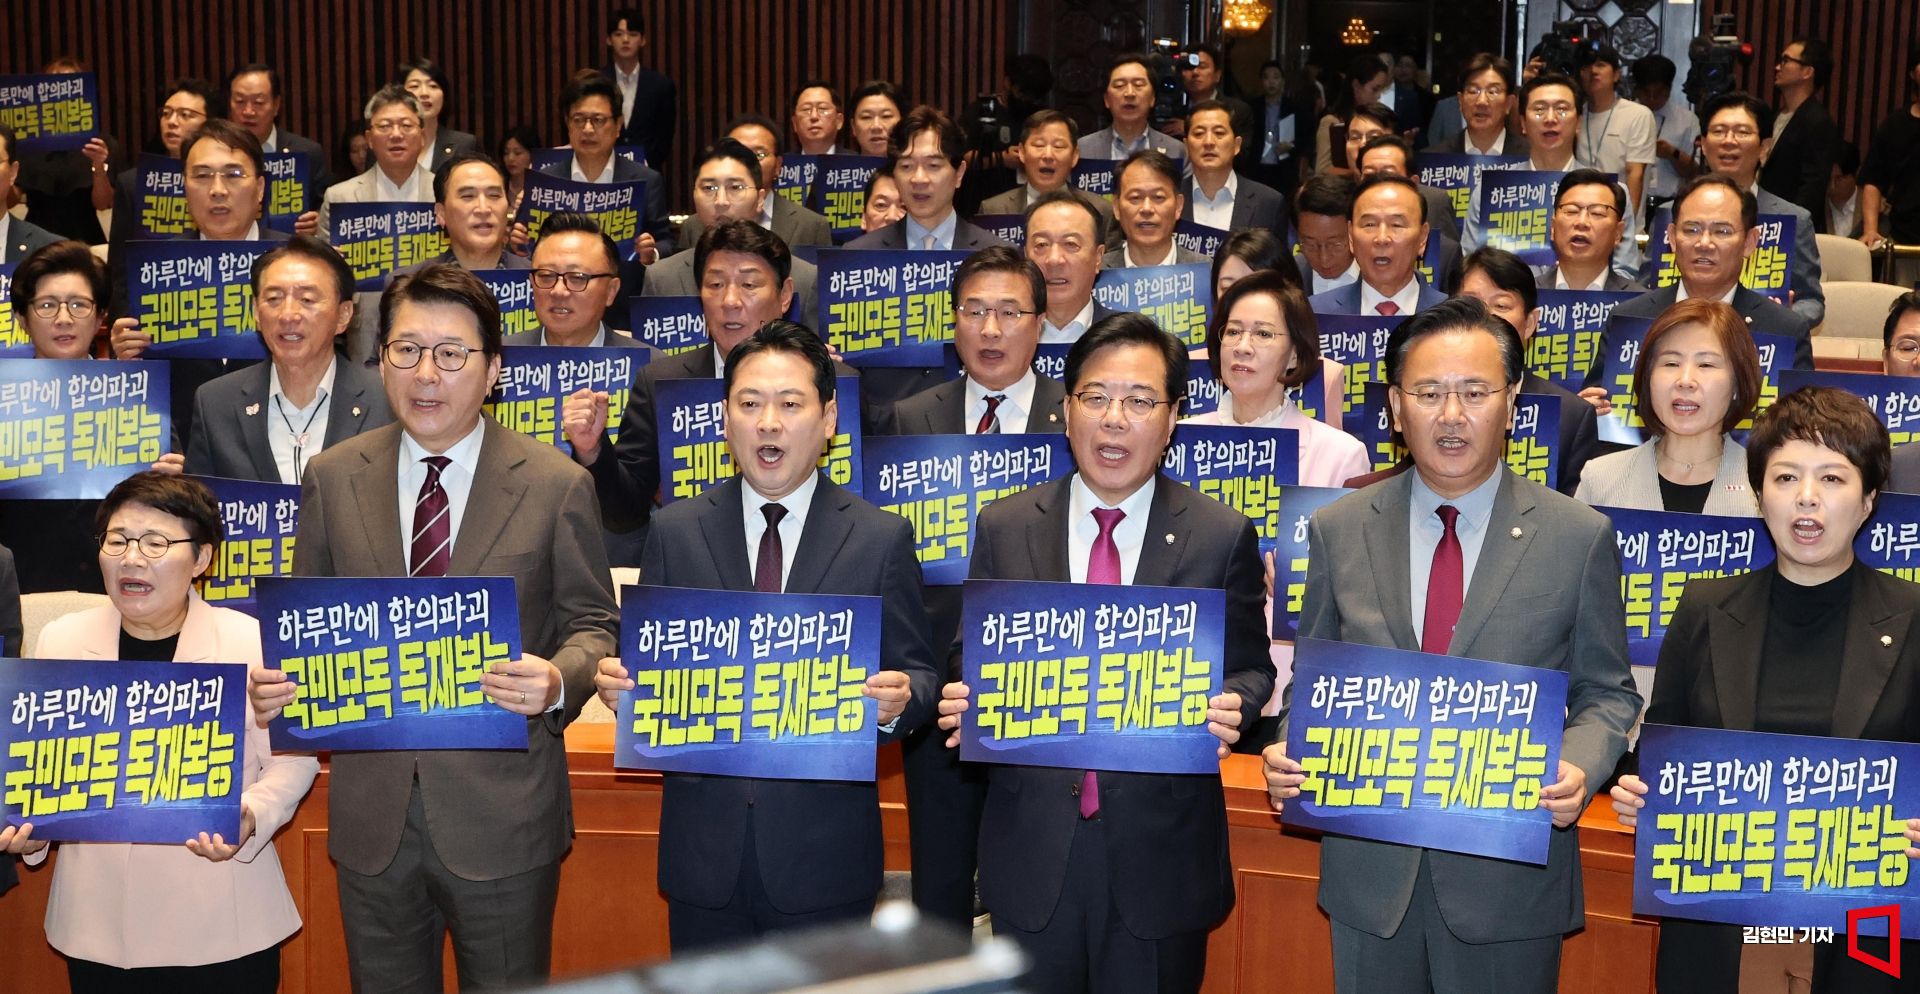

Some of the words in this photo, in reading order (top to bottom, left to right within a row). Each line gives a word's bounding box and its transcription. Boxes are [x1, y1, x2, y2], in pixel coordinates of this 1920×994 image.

[37, 78, 84, 103] 합의파괴
[41, 97, 93, 137] 독재본능
[531, 185, 580, 212] 하루만에
[583, 186, 634, 213] 합의파괴
[1421, 165, 1470, 188] 하루만에
[1490, 182, 1547, 209] 하루만에
[339, 213, 391, 241] 하루만에
[394, 209, 438, 235] 합의파
[1487, 207, 1548, 251] 국민모독
[140, 256, 213, 290] 하루만에
[218, 252, 263, 283] 합의
[829, 265, 898, 300] 하루만에
[901, 260, 963, 294] 합의파
[1134, 270, 1195, 307] 합의파괴
[140, 287, 218, 344] 국민모독
[828, 296, 901, 354] 국민모독
[68, 369, 149, 409] 합의파괴
[557, 356, 631, 393] 합의파괴
[71, 403, 162, 471] 독재본능
[1193, 438, 1277, 477] 합의파괴
[879, 454, 963, 499] 하루만에
[969, 443, 1051, 489] 합의파괴
[218, 499, 268, 536] 만에
[1657, 528, 1756, 569] 합의파괴
[277, 601, 379, 650] 하루만에
[387, 588, 490, 641] 합의파괴
[638, 615, 741, 662] 하루만에
[749, 608, 854, 660] 합의파괴
[982, 606, 1086, 655] 하루만에
[1094, 600, 1198, 650] 합의파괴
[11, 684, 119, 734] 하루만에
[126, 675, 225, 726] 합의파괴
[280, 646, 393, 730] 국민모독
[633, 665, 745, 748] 국민모독
[751, 653, 867, 741] 독재본능
[977, 655, 1090, 741] 국민모독
[1096, 646, 1211, 733] 독재본능
[1310, 674, 1421, 722] 하루만에
[1428, 675, 1538, 725] 합의파괴
[4, 731, 121, 818] 국민모독
[124, 720, 235, 806] 독재본능
[1299, 726, 1421, 808] 국민모독
[1422, 727, 1547, 810] 독재본능
[1658, 758, 1773, 806] 하루만에
[1782, 755, 1898, 805] 합의파괴
[1652, 810, 1777, 895] 국민모독
[1783, 803, 1912, 892] 독재본능
